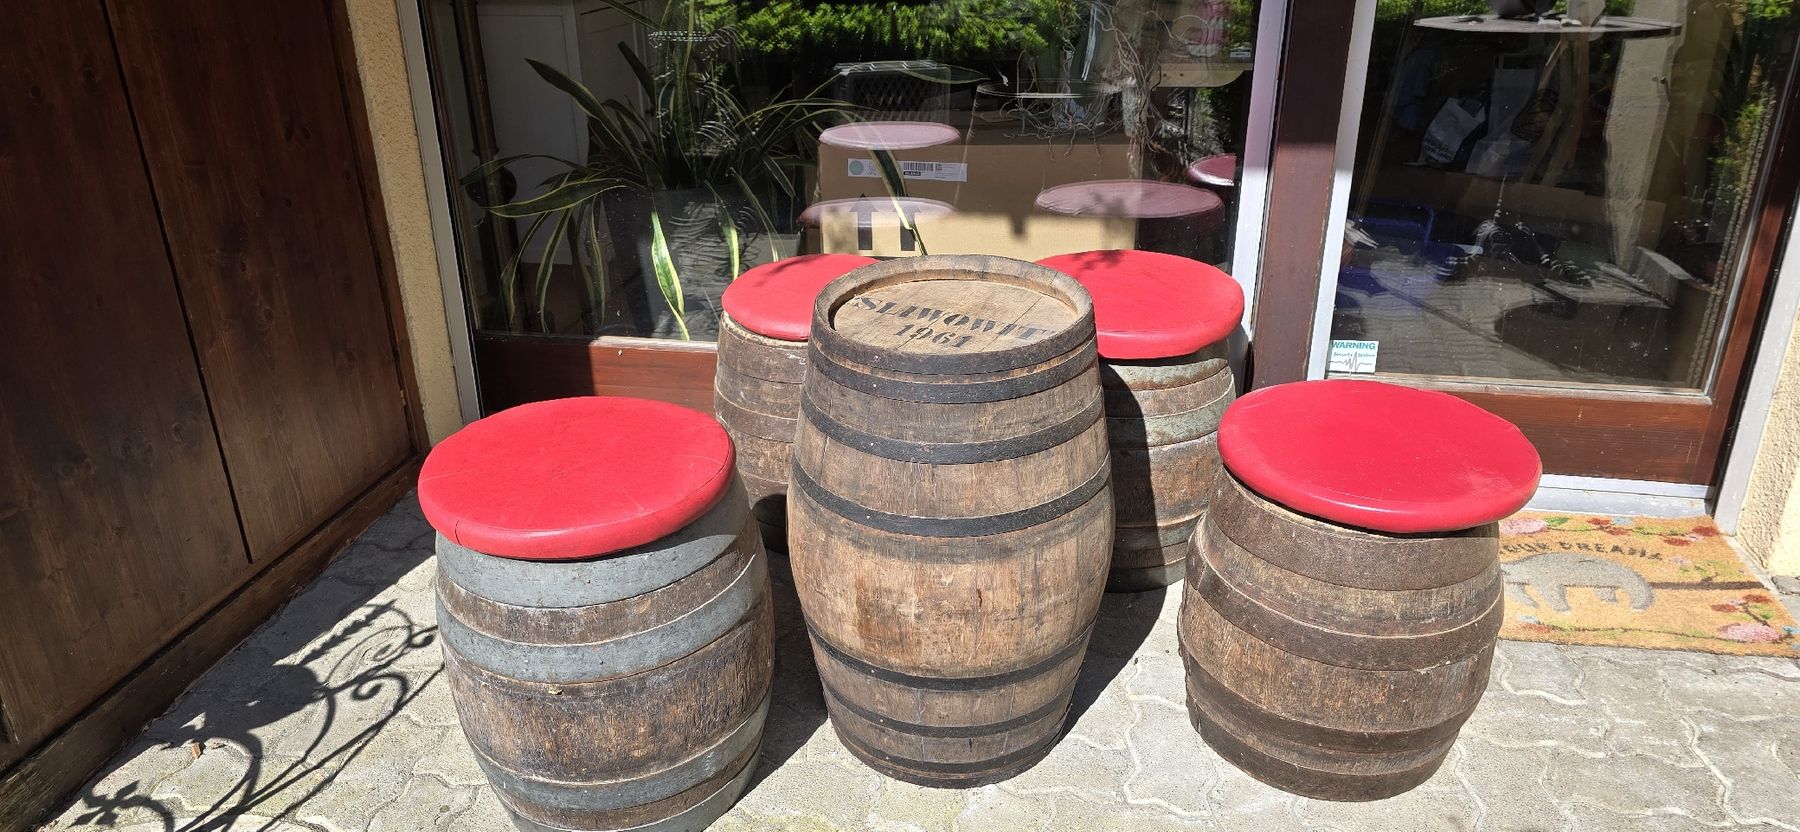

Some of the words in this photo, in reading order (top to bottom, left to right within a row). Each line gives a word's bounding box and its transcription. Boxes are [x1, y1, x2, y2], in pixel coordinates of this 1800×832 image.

[854, 297, 1056, 340] SLIWOWIT
[894, 324, 973, 347] 1961
[1331, 342, 1376, 350] WARNING
[1499, 542, 1552, 554] OUR
